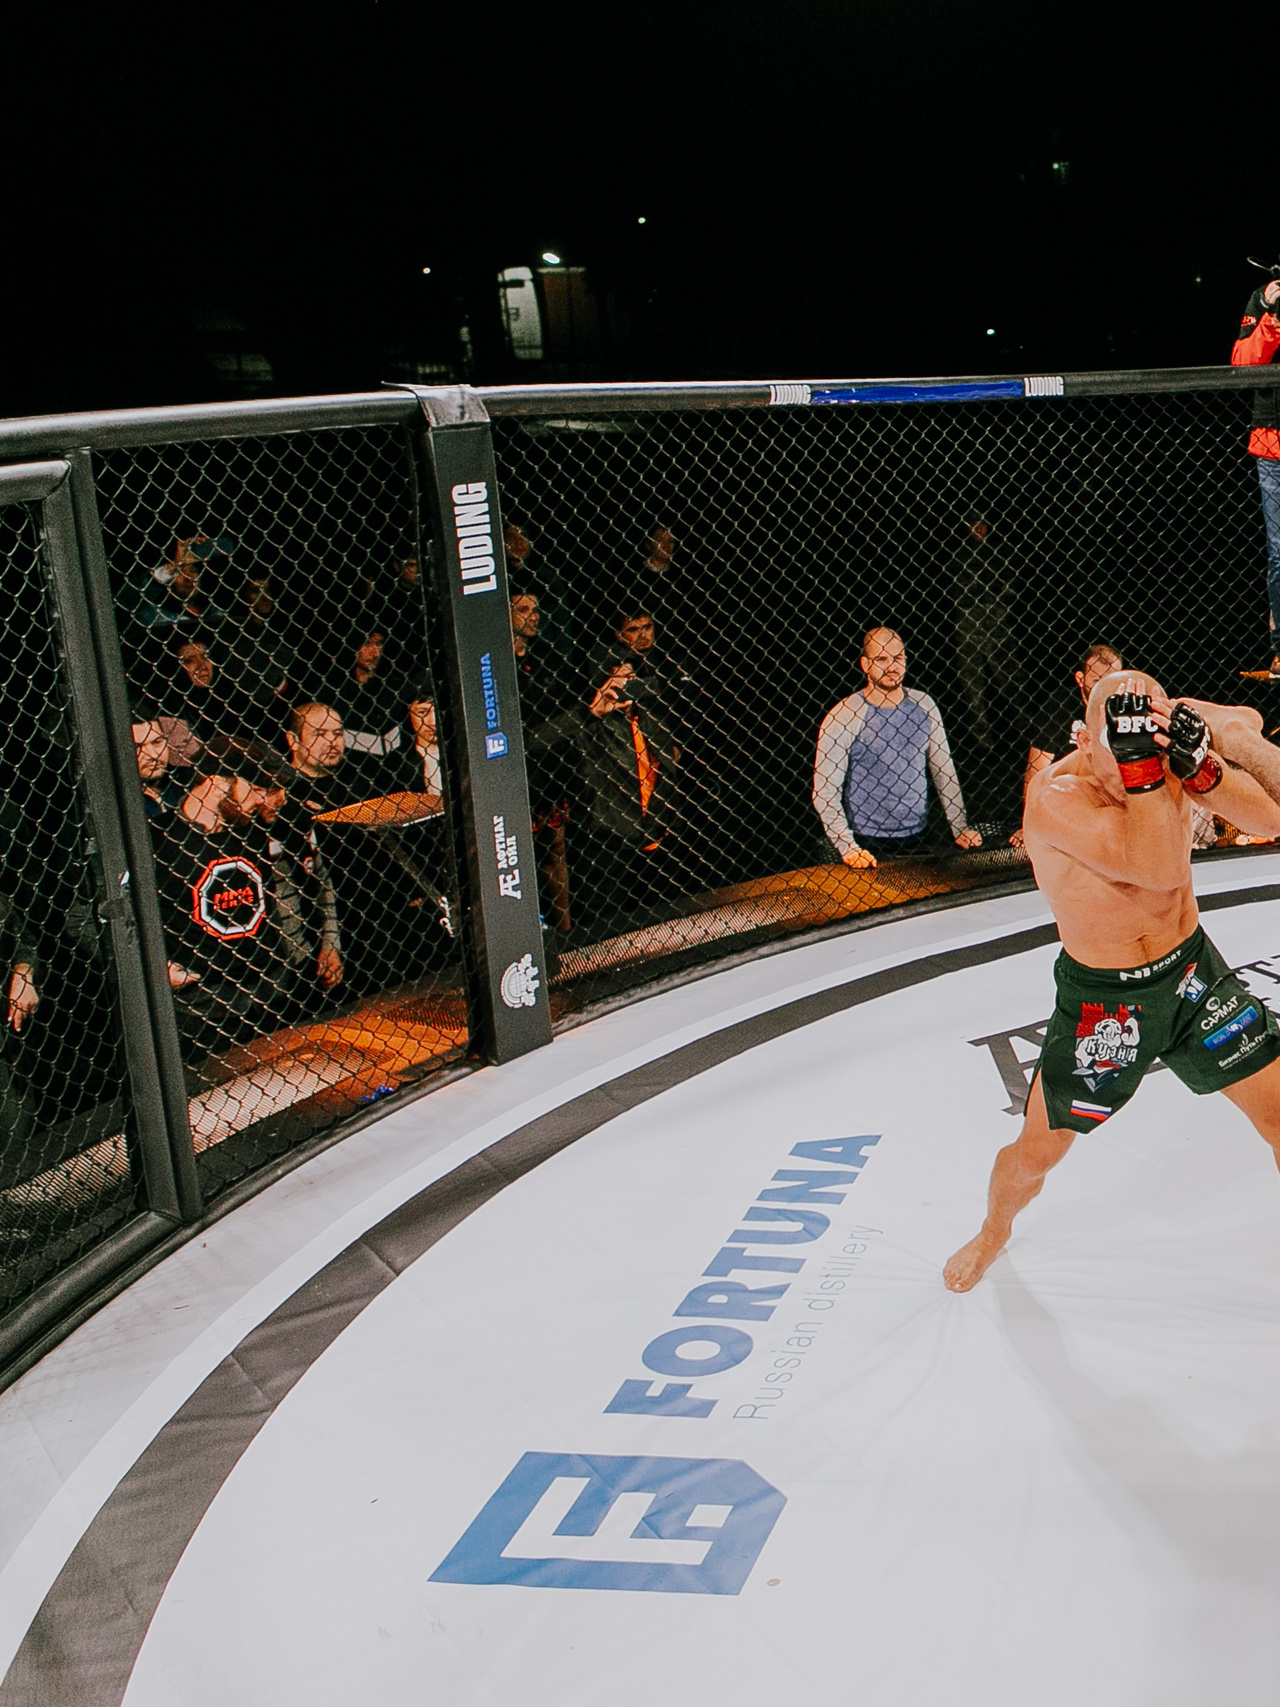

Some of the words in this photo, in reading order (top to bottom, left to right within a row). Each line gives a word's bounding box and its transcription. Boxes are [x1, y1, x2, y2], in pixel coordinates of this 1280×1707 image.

[452, 483, 498, 596] LUDING
[480, 652, 498, 731] FORTUNA
[1117, 716, 1158, 733] BFC
[1152, 950, 1182, 972] SPORT
[602, 1134, 884, 1419] FORTUNA
[732, 1321, 823, 1420] Russian
[807, 1225, 884, 1312] distillery
